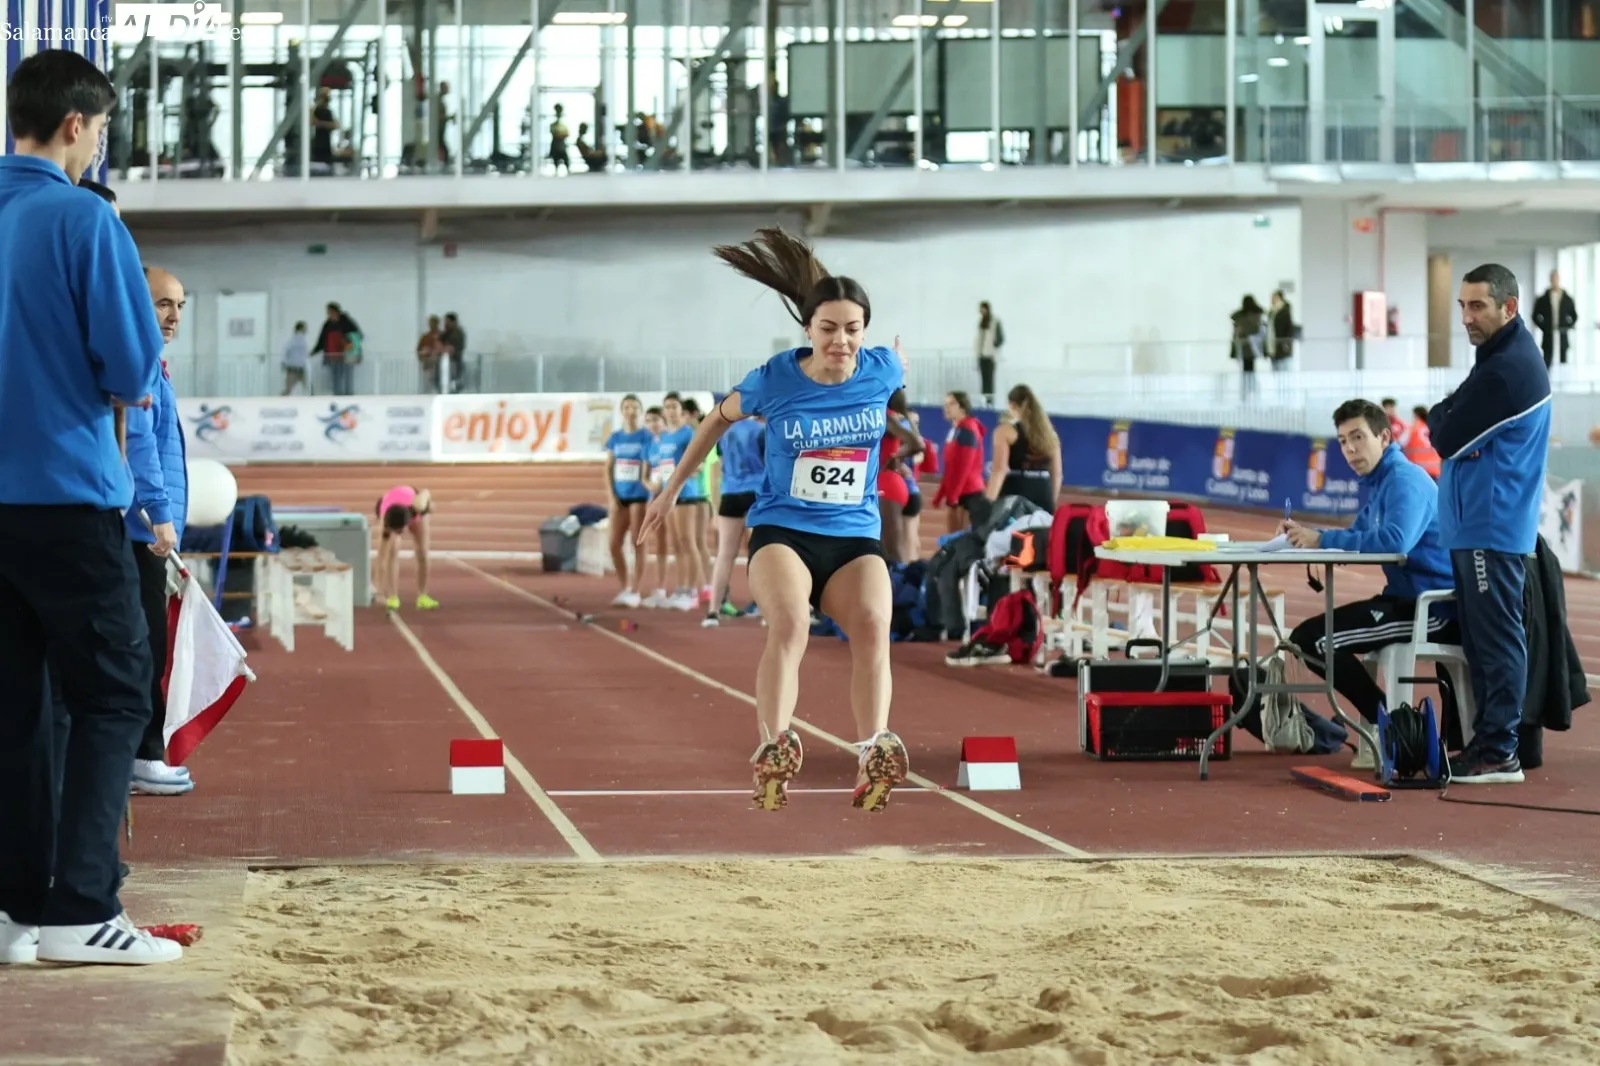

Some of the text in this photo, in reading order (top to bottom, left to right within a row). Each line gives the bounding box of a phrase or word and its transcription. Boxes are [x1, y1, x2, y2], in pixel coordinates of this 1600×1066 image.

[443, 401, 573, 453] enjoy!
[784, 407, 885, 440] LA ARMUÑA
[792, 440, 819, 450] CLUB
[810, 465, 856, 486] 624
